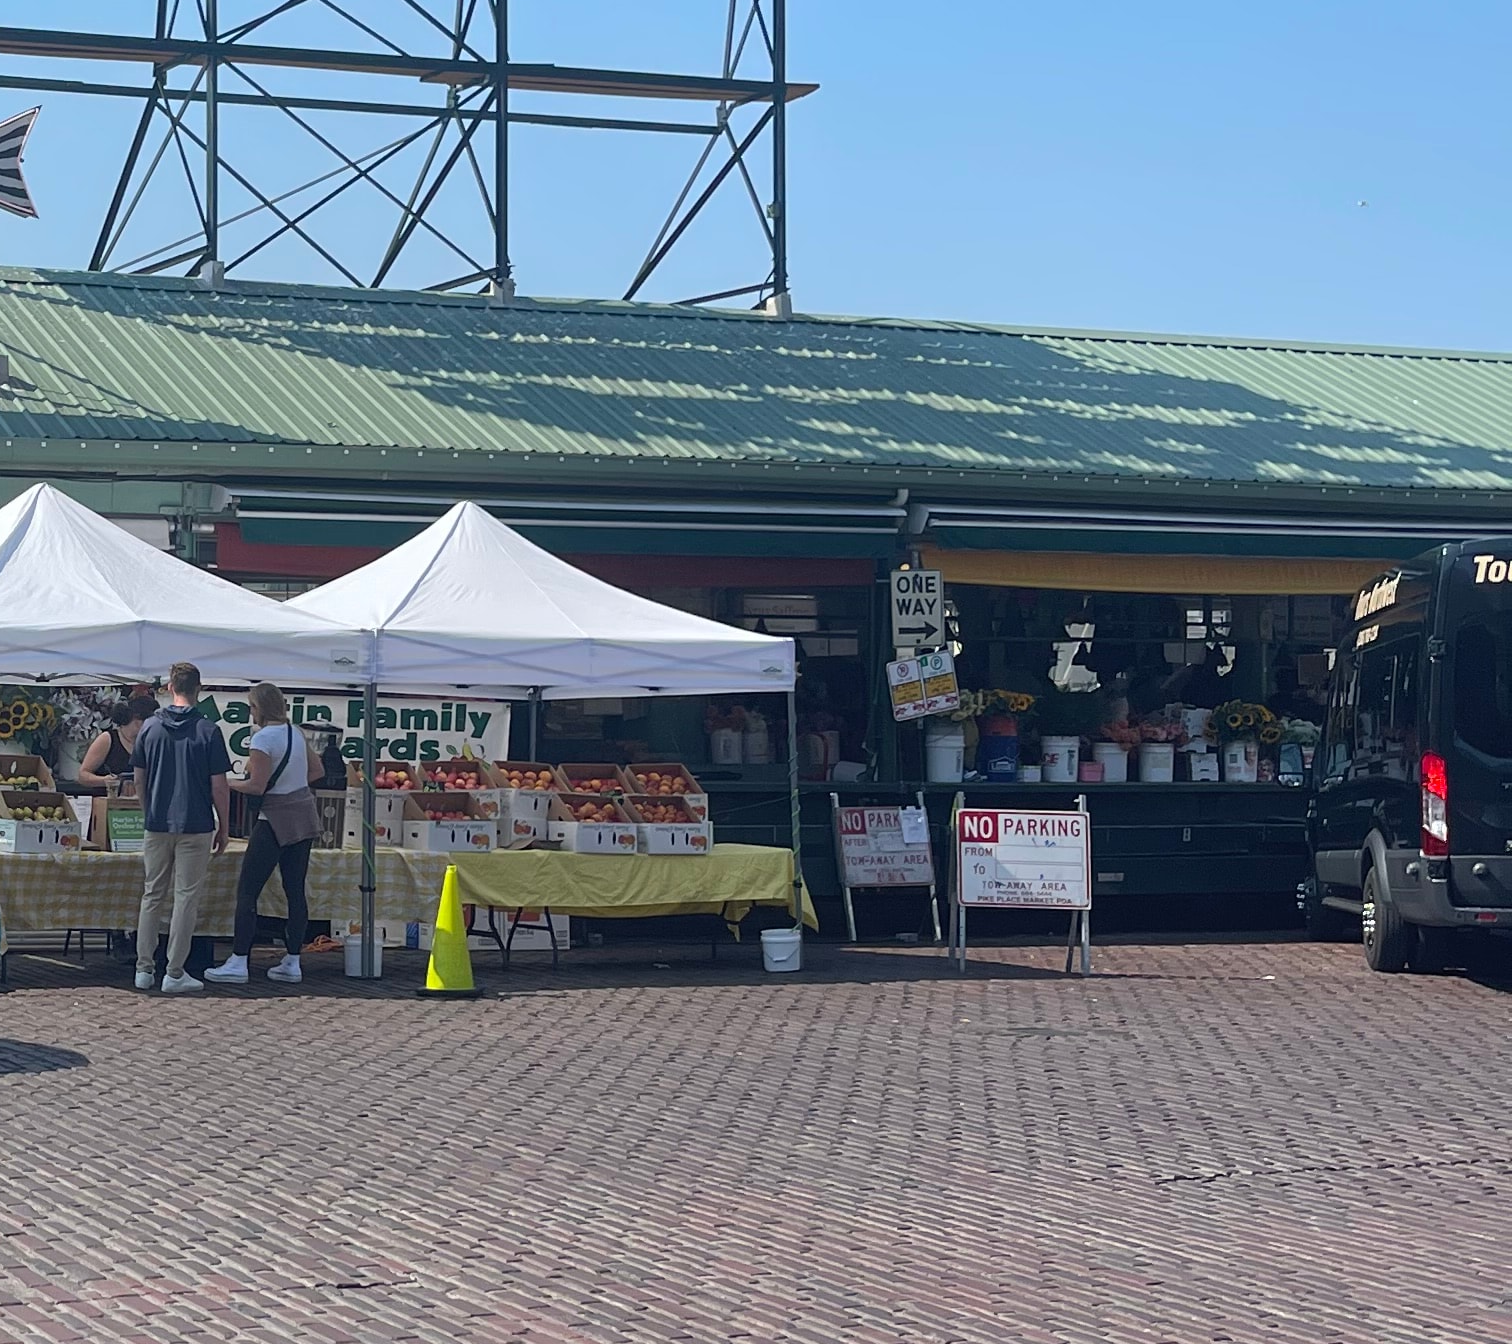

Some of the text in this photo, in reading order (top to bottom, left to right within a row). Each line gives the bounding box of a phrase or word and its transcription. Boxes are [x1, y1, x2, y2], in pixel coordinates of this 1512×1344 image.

[897, 576, 937, 594] ONE
[896, 598, 938, 616] WAY
[347, 700, 492, 738] Family
[841, 812, 862, 831] NO
[868, 811, 900, 828] PARK
[964, 815, 1081, 839] NO PARKING
[844, 838, 868, 847] AFTER
[964, 847, 993, 857] FROM
[846, 854, 929, 866] TOW-AWAY AREA
[982, 880, 1067, 892] TOW-AWAY AREA
[1023, 896, 1054, 904] MARKET
